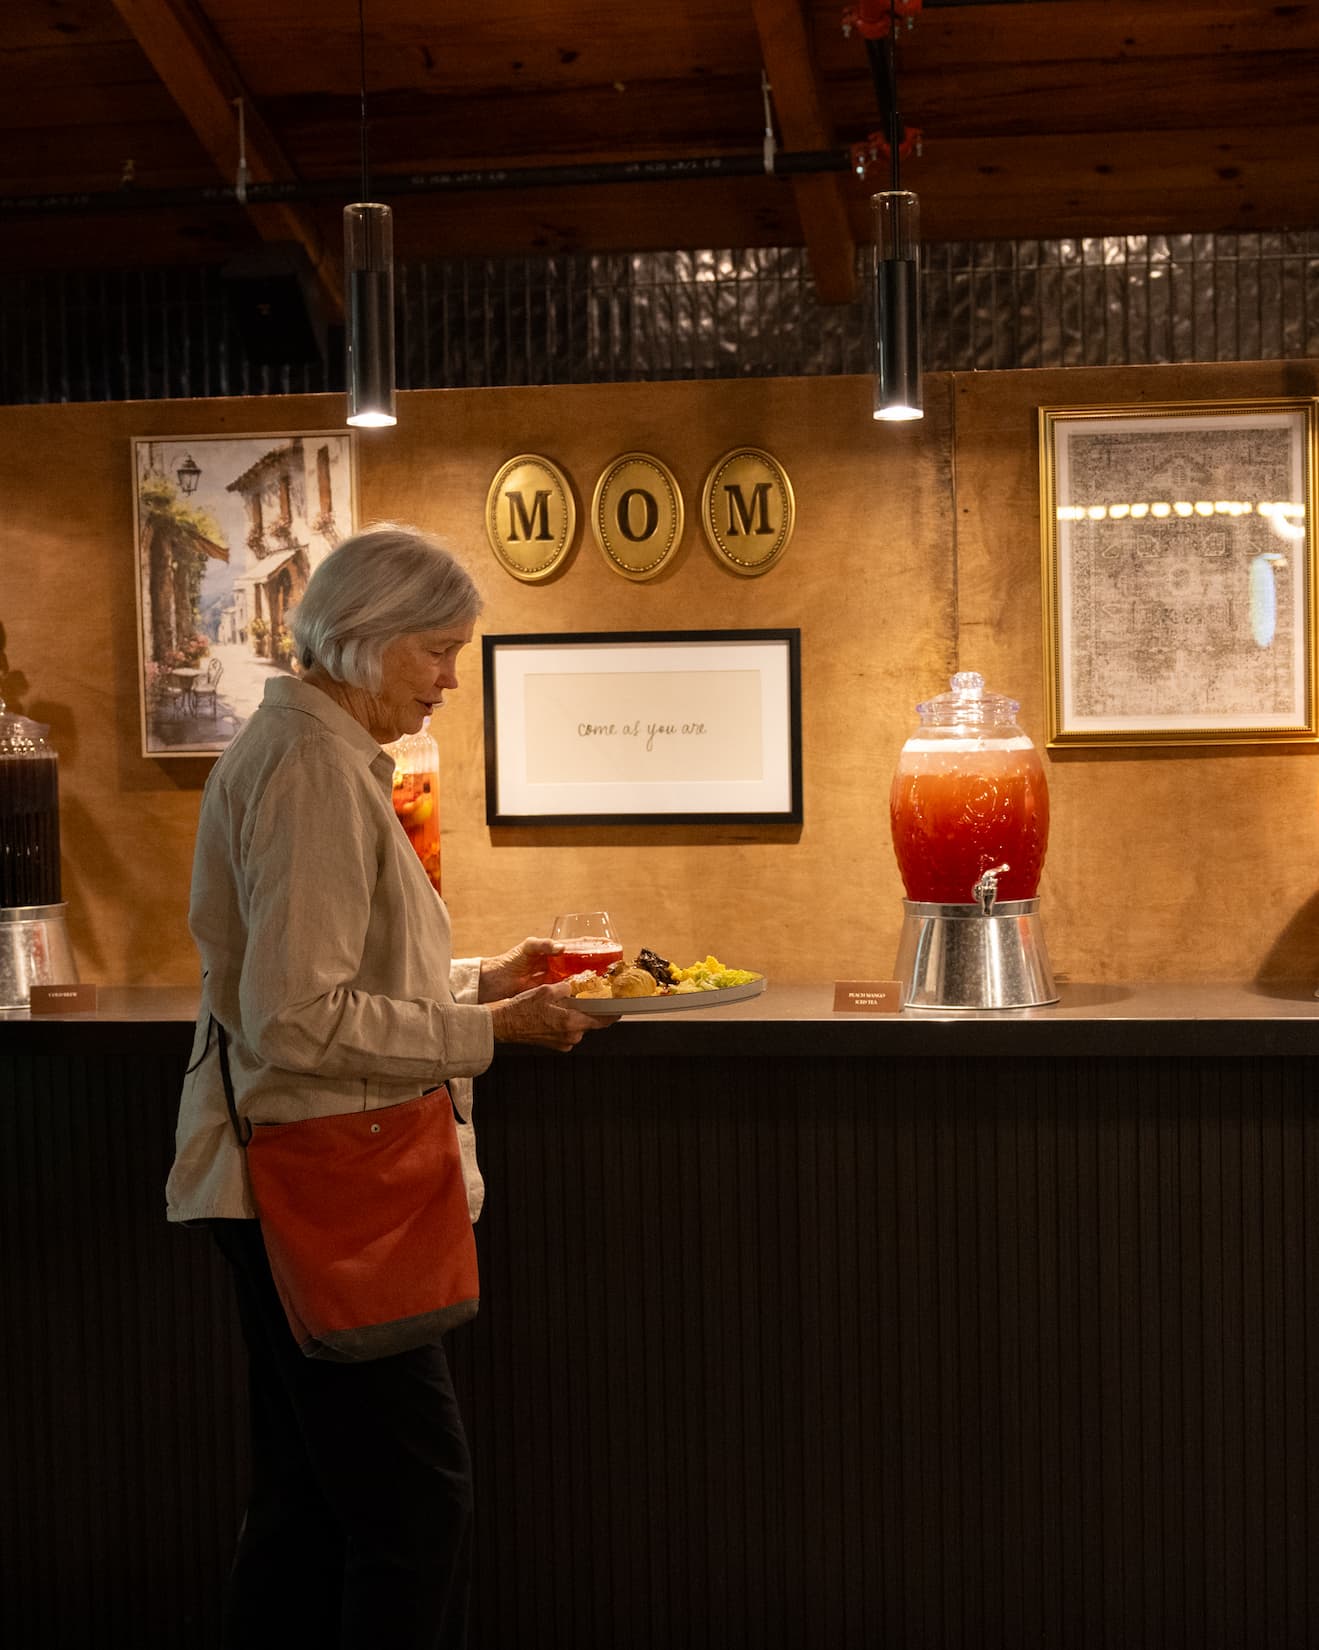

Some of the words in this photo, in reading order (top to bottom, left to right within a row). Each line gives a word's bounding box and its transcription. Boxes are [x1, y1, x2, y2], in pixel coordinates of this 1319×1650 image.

[577, 722, 617, 737] come
[647, 722, 678, 752] you
[681, 722, 707, 736] are
